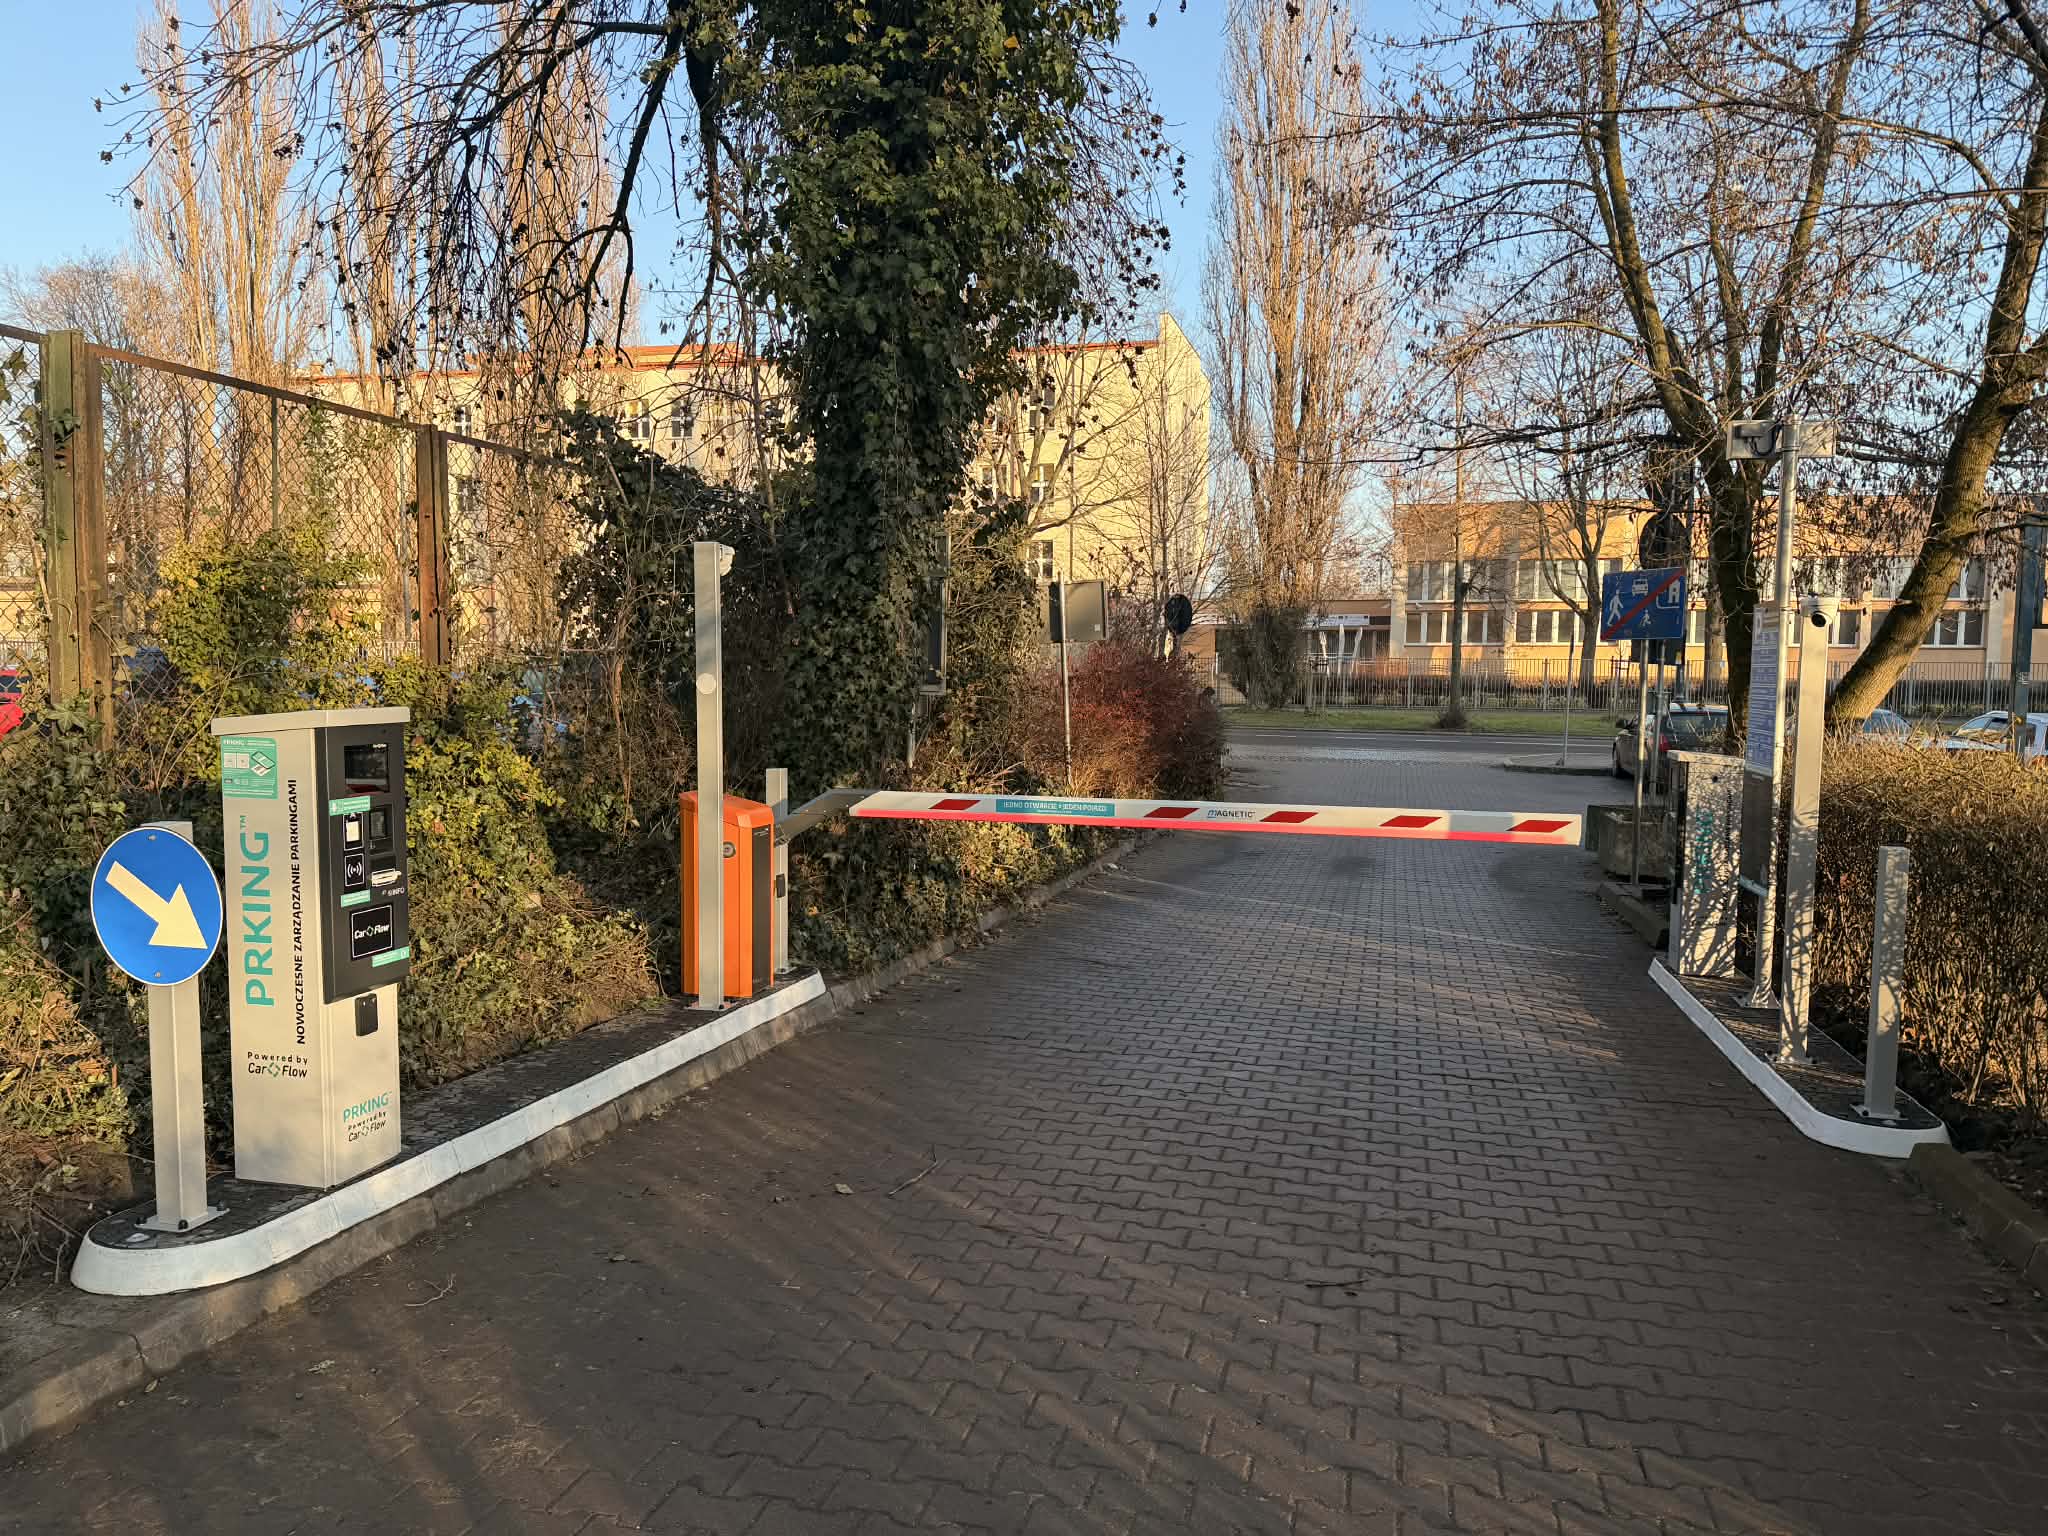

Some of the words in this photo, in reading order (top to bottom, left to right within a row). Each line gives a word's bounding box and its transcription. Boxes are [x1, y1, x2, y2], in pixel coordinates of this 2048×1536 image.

[287, 779, 300, 861] PARKINGAMI
[291, 863, 304, 952] ZARZĄDZANIE
[354, 930, 367, 940] Car
[374, 924, 390, 935] Flow
[294, 955, 306, 1045] NOWOCZESNE
[247, 1051, 293, 1063] Powered
[296, 1055, 308, 1066] by
[248, 1062, 268, 1075] Car
[282, 1065, 308, 1078] Flow
[348, 1131, 361, 1142] Car
[370, 1120, 387, 1132] Flow
